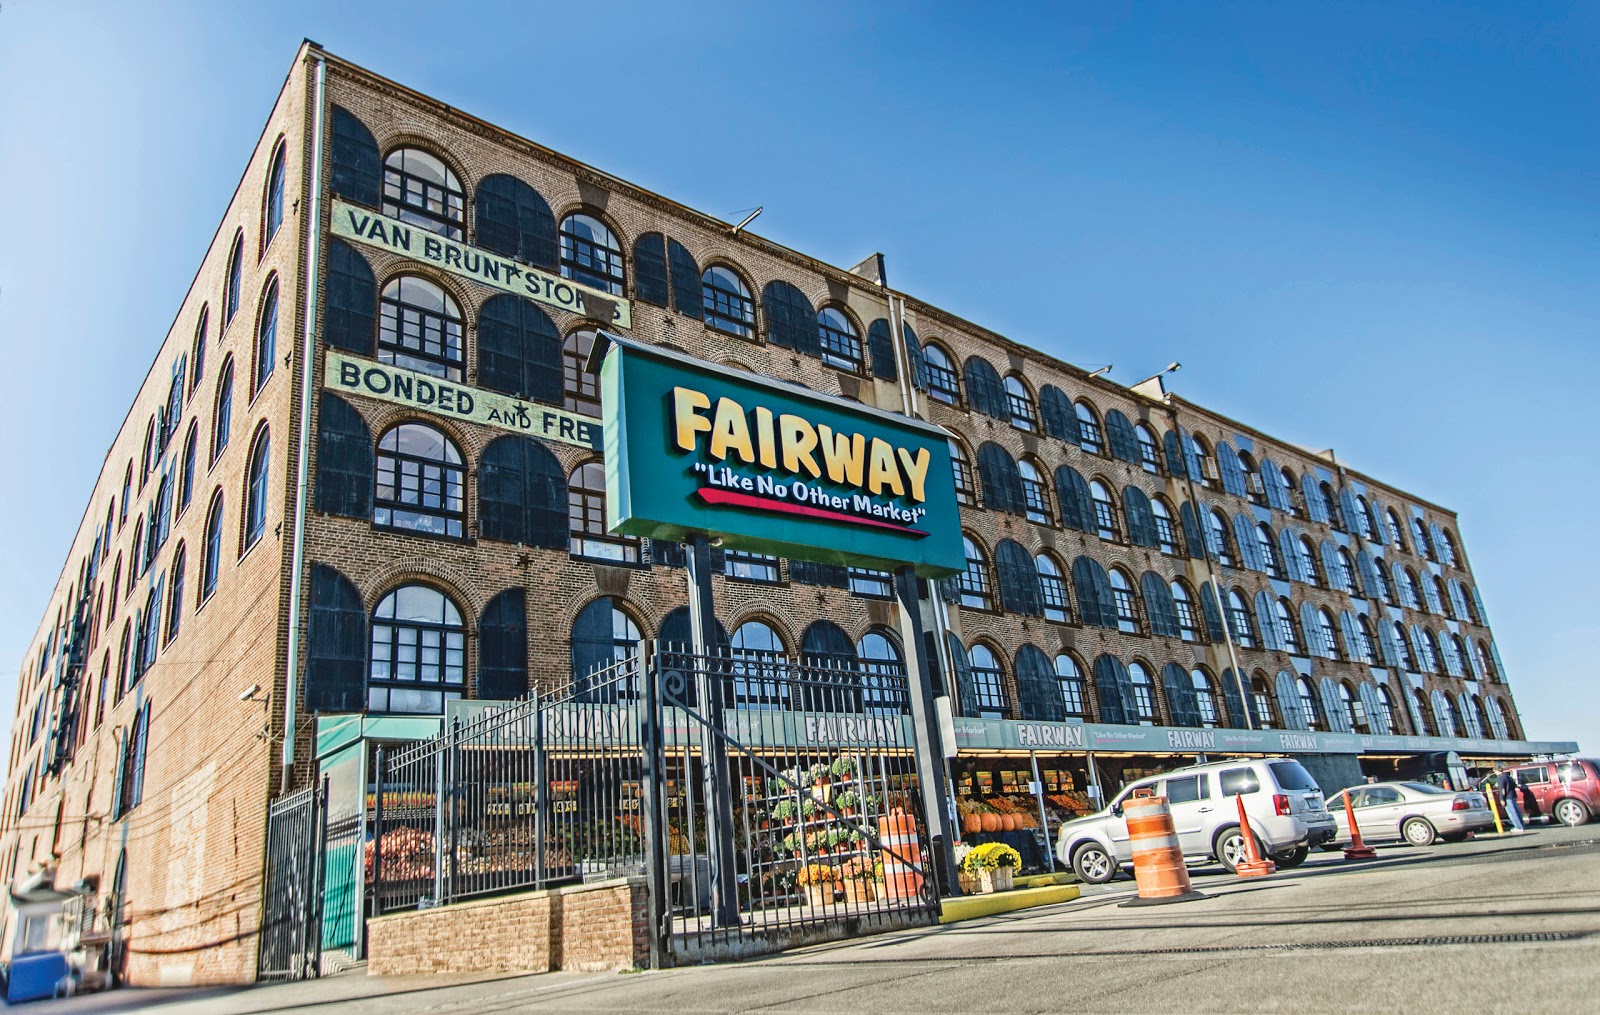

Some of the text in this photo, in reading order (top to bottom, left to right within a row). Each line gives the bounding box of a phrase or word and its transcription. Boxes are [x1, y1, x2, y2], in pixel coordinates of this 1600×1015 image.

[348, 210, 411, 252] VAN
[424, 236, 514, 285] BRUNT
[340, 361, 474, 415] BONDED
[487, 408, 531, 429] AND
[671, 386, 931, 503] FAIRWAY
[694, 462, 927, 523] "Like No Other Market"
[805, 716, 898, 743] FAIRWAY
[1016, 724, 1083, 747] FAIRWAY
[1166, 730, 1216, 749] FAIRWAY
[1279, 733, 1318, 750] FAIRWAY
